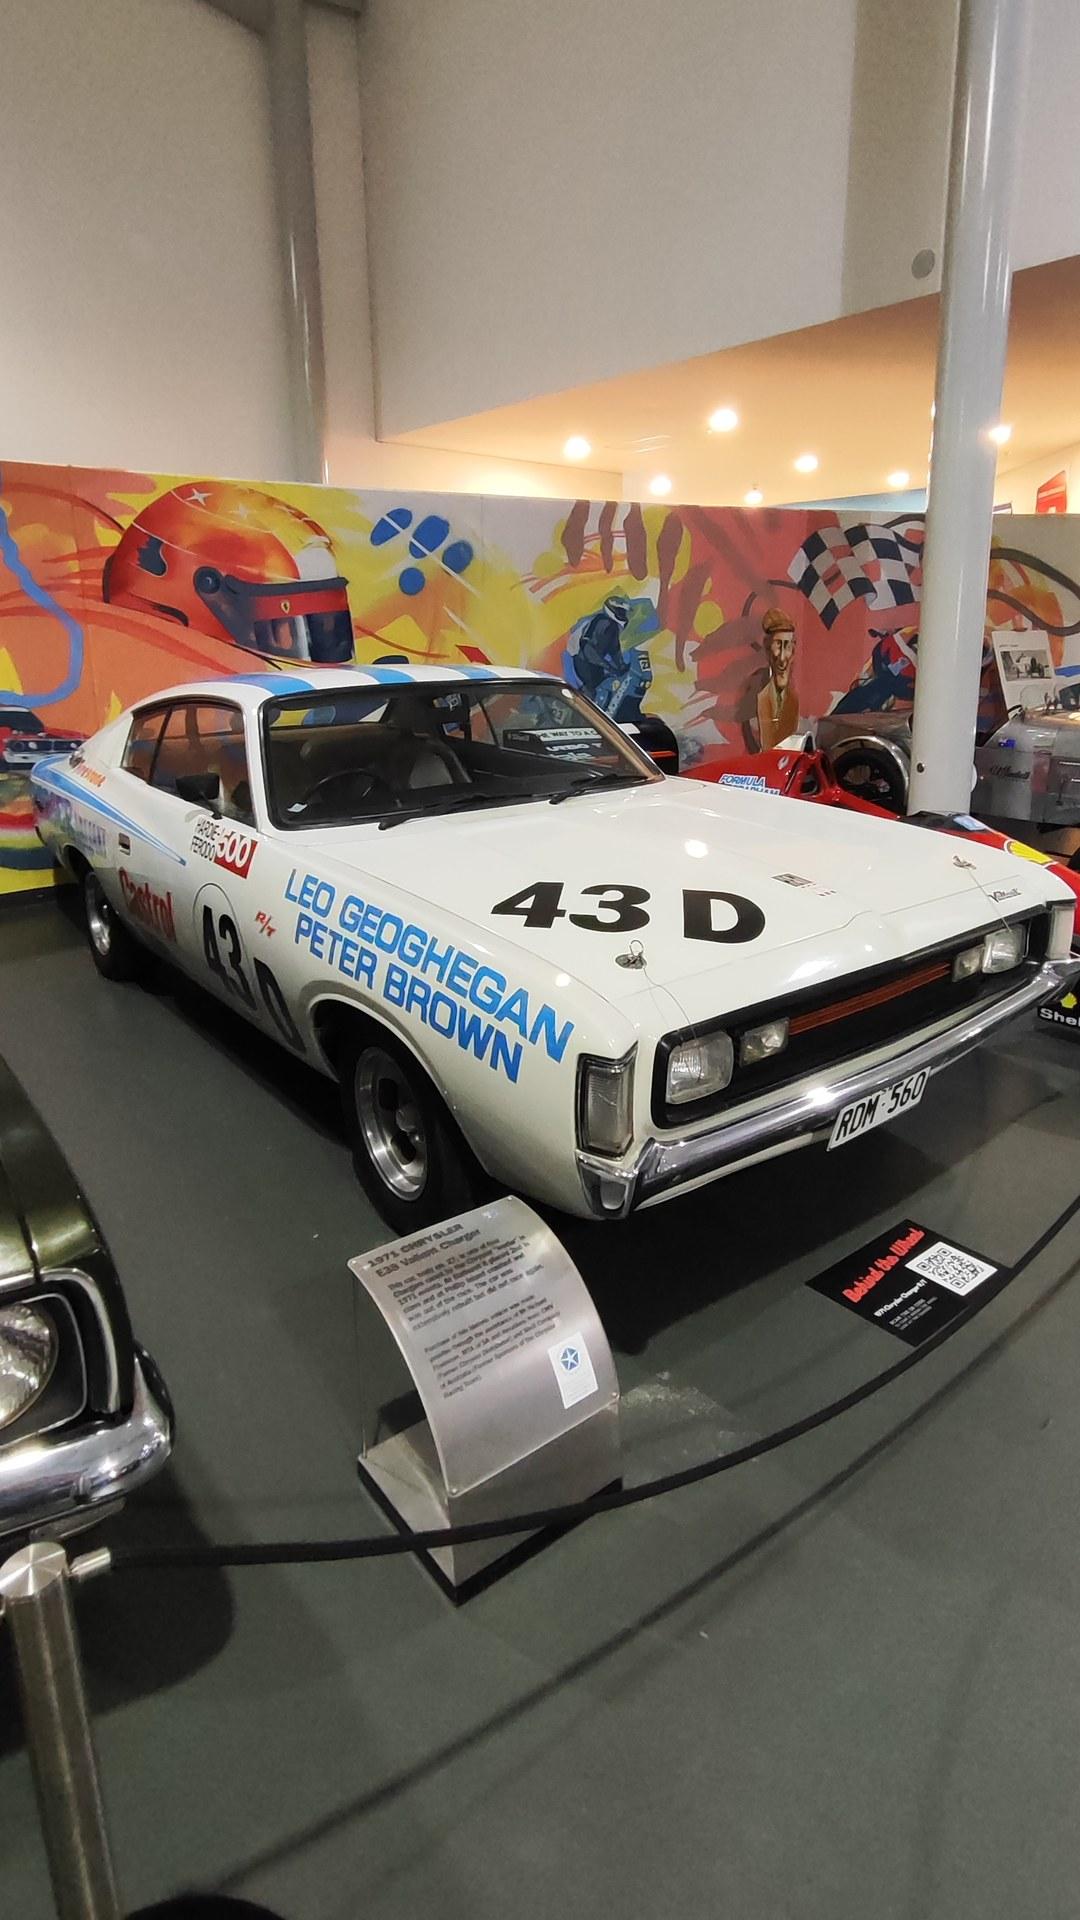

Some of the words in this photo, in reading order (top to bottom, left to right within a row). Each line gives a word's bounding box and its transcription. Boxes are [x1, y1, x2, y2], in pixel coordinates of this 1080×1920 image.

[719, 774, 766, 787] FORMULA
[216, 829, 253, 868] 500
[119, 866, 178, 943] Castrol
[254, 910, 277, 937] R/T
[490, 881, 651, 933] 43
[681, 888, 766, 944] D
[203, 904, 258, 1011] 43
[284, 868, 336, 919] LEO
[338, 894, 575, 1064] GEOGHEGAN
[294, 911, 379, 990] PETER
[383, 962, 523, 1084] BROWN
[886, 1070, 928, 1114] 560
[368, 1250, 398, 1267] 1971
[400, 1223, 463, 1253] CHRYSLER
[842, 1265, 886, 1304] Behind
[874, 1255, 900, 1272] the
